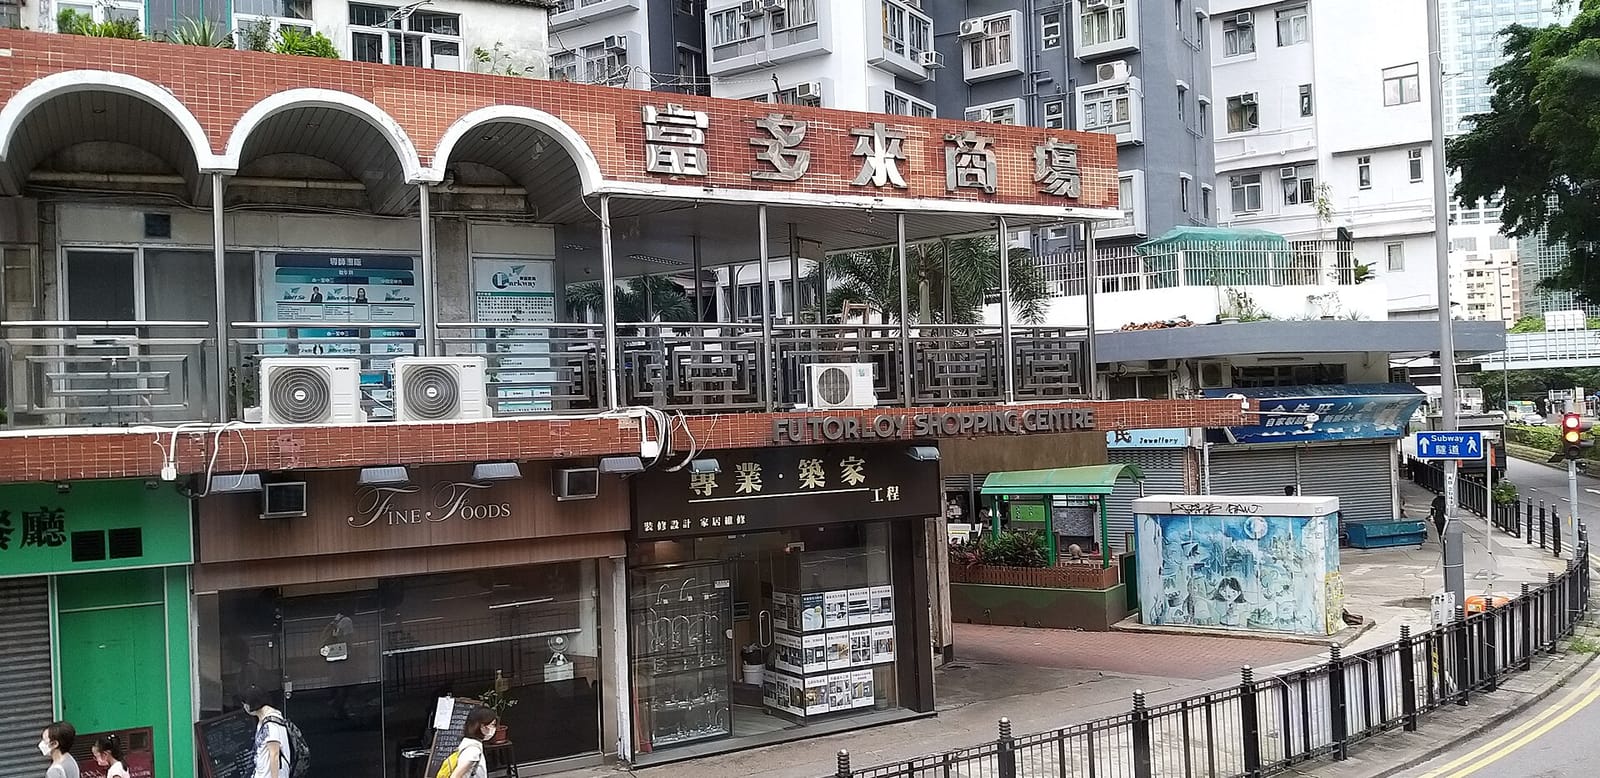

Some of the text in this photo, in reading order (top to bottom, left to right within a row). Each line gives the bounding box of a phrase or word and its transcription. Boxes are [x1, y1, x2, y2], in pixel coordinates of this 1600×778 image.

[642, 103, 1083, 199] 富多來商場
[773, 407, 1096, 442] FU TOR LOY SHOPPING CENTRE
[1139, 437, 1179, 445] Jewellery
[1431, 435, 1465, 443] Subway
[1435, 444, 1460, 455] 隧道
[870, 485, 900, 503] 工程
